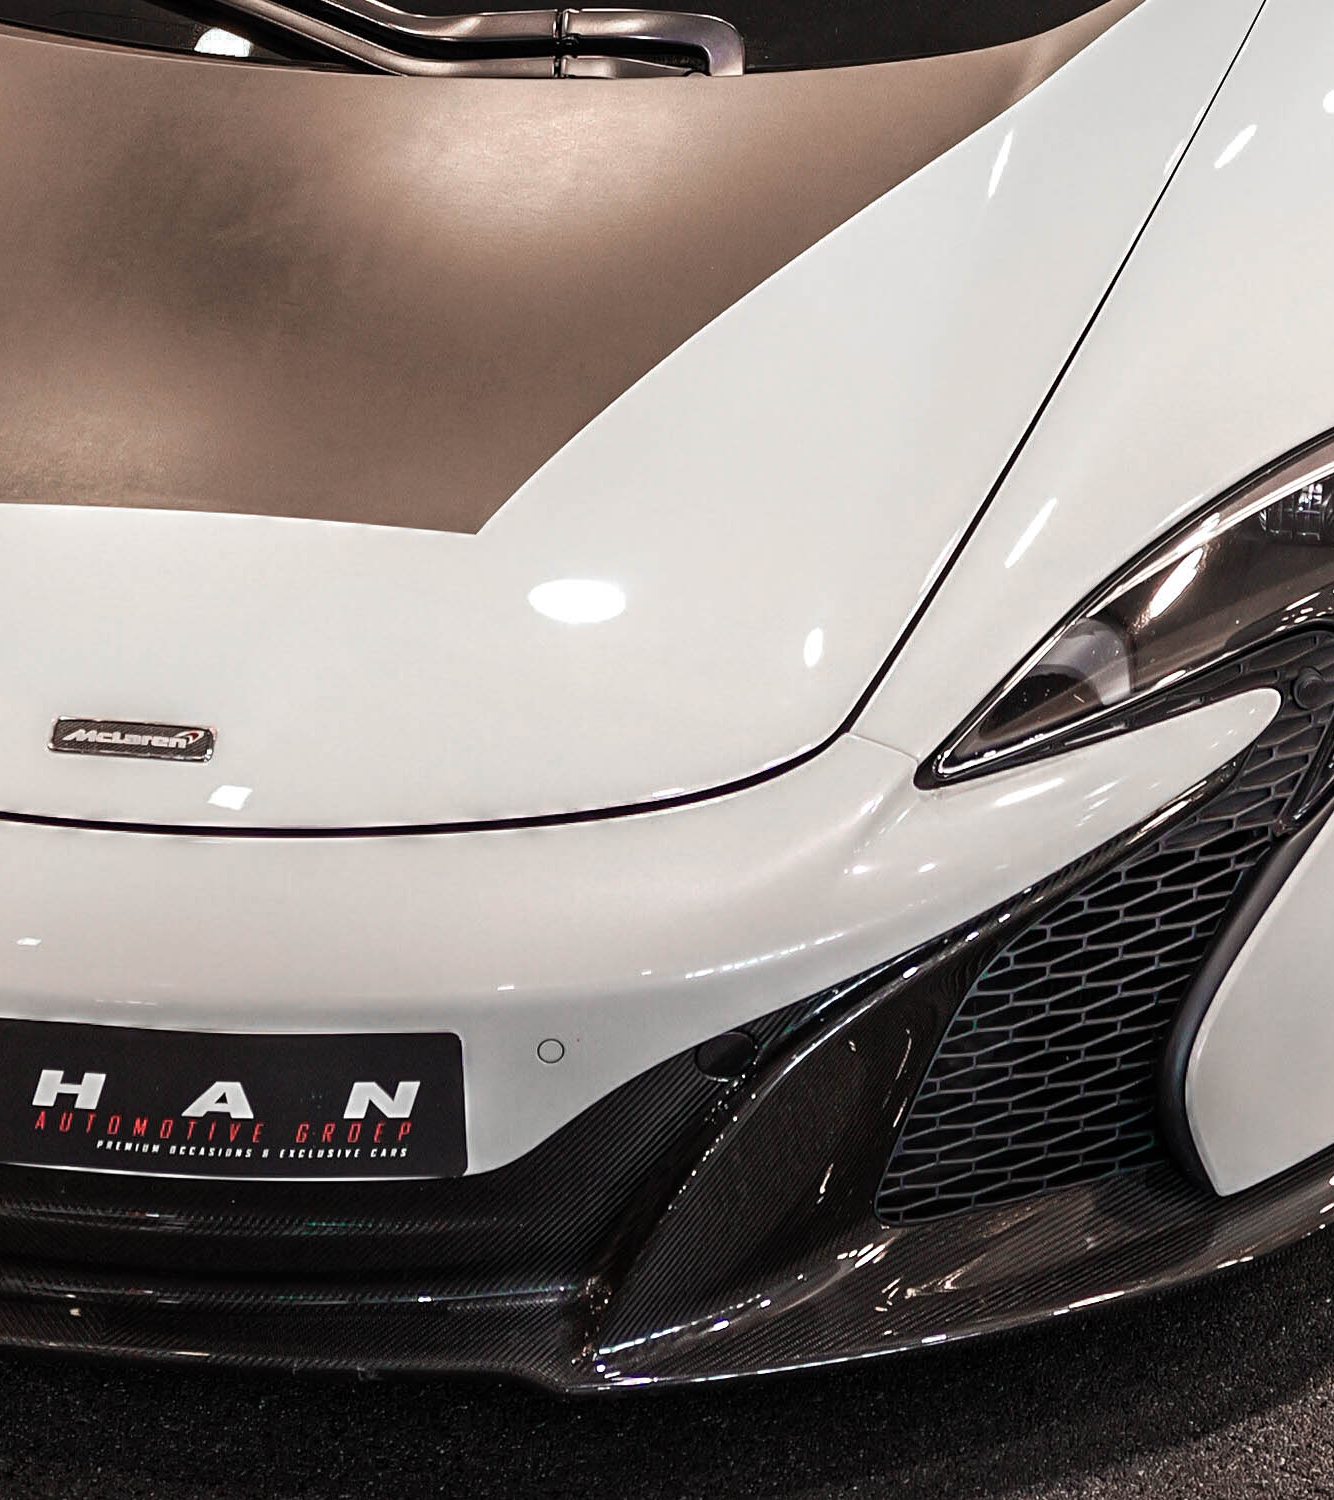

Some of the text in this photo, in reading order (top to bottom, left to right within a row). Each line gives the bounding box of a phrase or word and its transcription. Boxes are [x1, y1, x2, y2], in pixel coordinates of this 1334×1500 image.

[61, 728, 188, 750] McLaren
[34, 1110, 412, 1144] AUTOMOTIVE GROEP
[96, 1140, 161, 1154] PREMIUM
[169, 1145, 253, 1158] OCCASIONS
[280, 1148, 361, 1159] EXCLUSIVE
[370, 1148, 409, 1158] CARS
